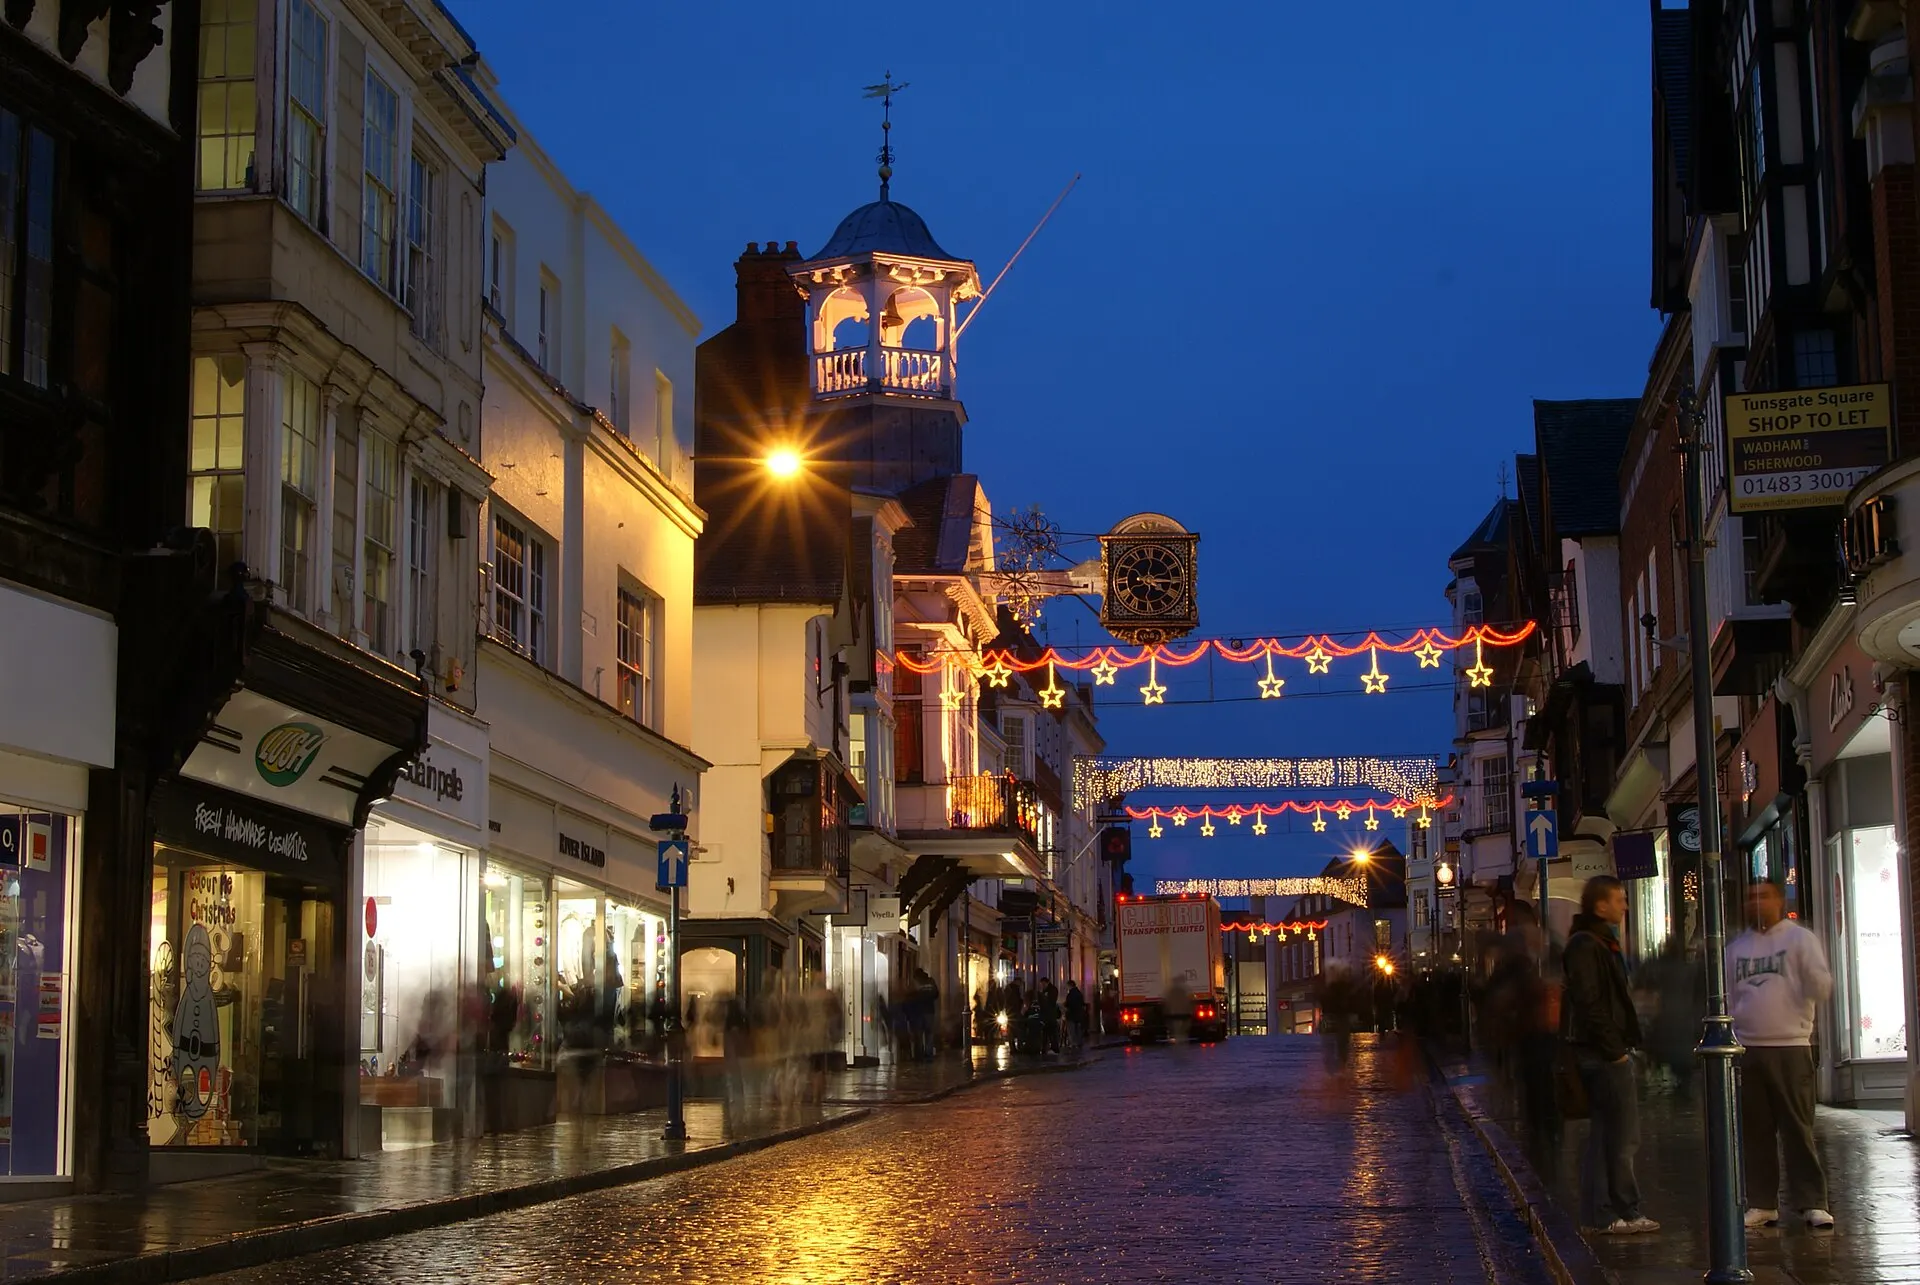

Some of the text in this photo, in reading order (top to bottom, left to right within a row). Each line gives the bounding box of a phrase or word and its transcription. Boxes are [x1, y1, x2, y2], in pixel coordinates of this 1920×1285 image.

[1742, 391, 1874, 411] Tunsgate Square
[1749, 410, 1870, 433] SHOP TO LET
[1742, 438, 1802, 455] WADHAM
[1743, 454, 1822, 472] ISHERWOOD
[1743, 475, 1802, 495] 01483
[258, 729, 331, 775] LUSH
[194, 802, 308, 862] FRESH HANDMADE COSMETICS
[559, 832, 605, 869] RIVER ISLAND
[189, 867, 218, 896] Colour
[190, 897, 236, 925] Christmas
[871, 911, 895, 921] Viyella
[1122, 925, 1205, 936] TRANSPORT LIMITED
